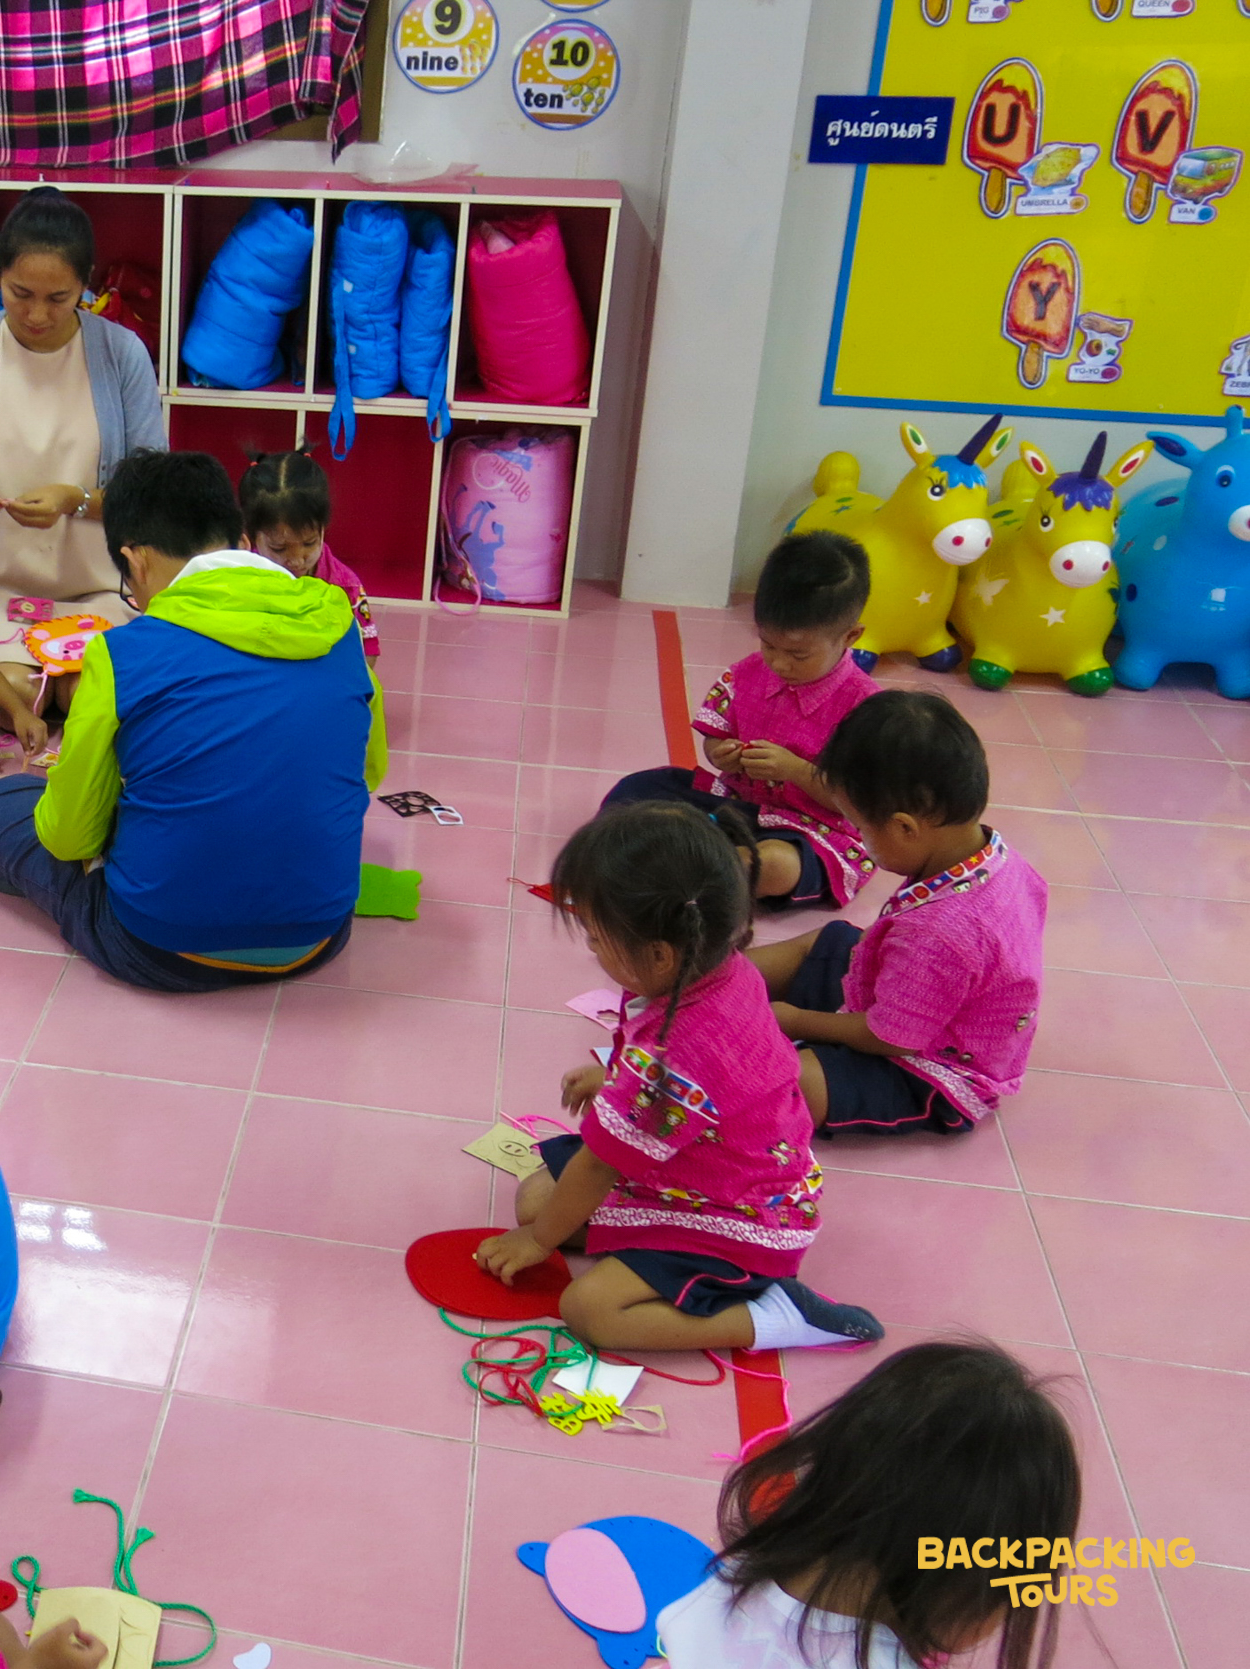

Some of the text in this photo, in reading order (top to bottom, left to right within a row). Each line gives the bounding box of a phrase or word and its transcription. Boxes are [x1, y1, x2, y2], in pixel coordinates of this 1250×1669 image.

[435, 0, 462, 35] 9
[406, 51, 459, 71] nine
[549, 40, 590, 67] 10
[524, 88, 563, 109] ten
[826, 110, 938, 146] ศูนย์ดนตรี
[983, 103, 1020, 144] U
[1136, 111, 1175, 153] V
[1021, 198, 1068, 207] UMBRELLA
[1177, 207, 1196, 215] VAN
[1030, 282, 1060, 321] Y
